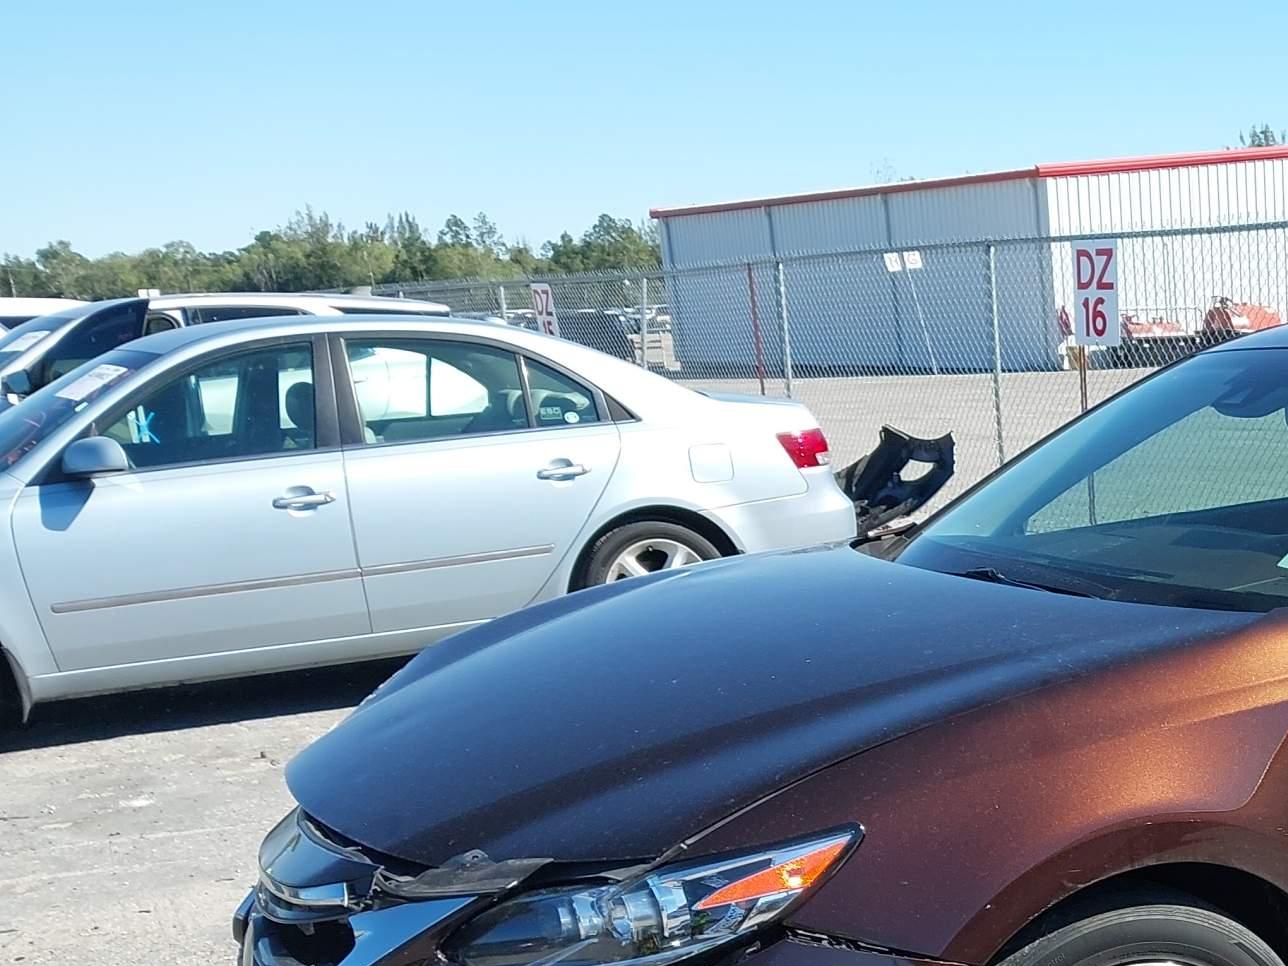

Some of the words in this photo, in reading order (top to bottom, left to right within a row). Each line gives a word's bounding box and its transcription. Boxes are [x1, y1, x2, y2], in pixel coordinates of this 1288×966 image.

[1075, 248, 1115, 291] DZ
[533, 289, 553, 316] DZ
[1082, 296, 1107, 337] 16
